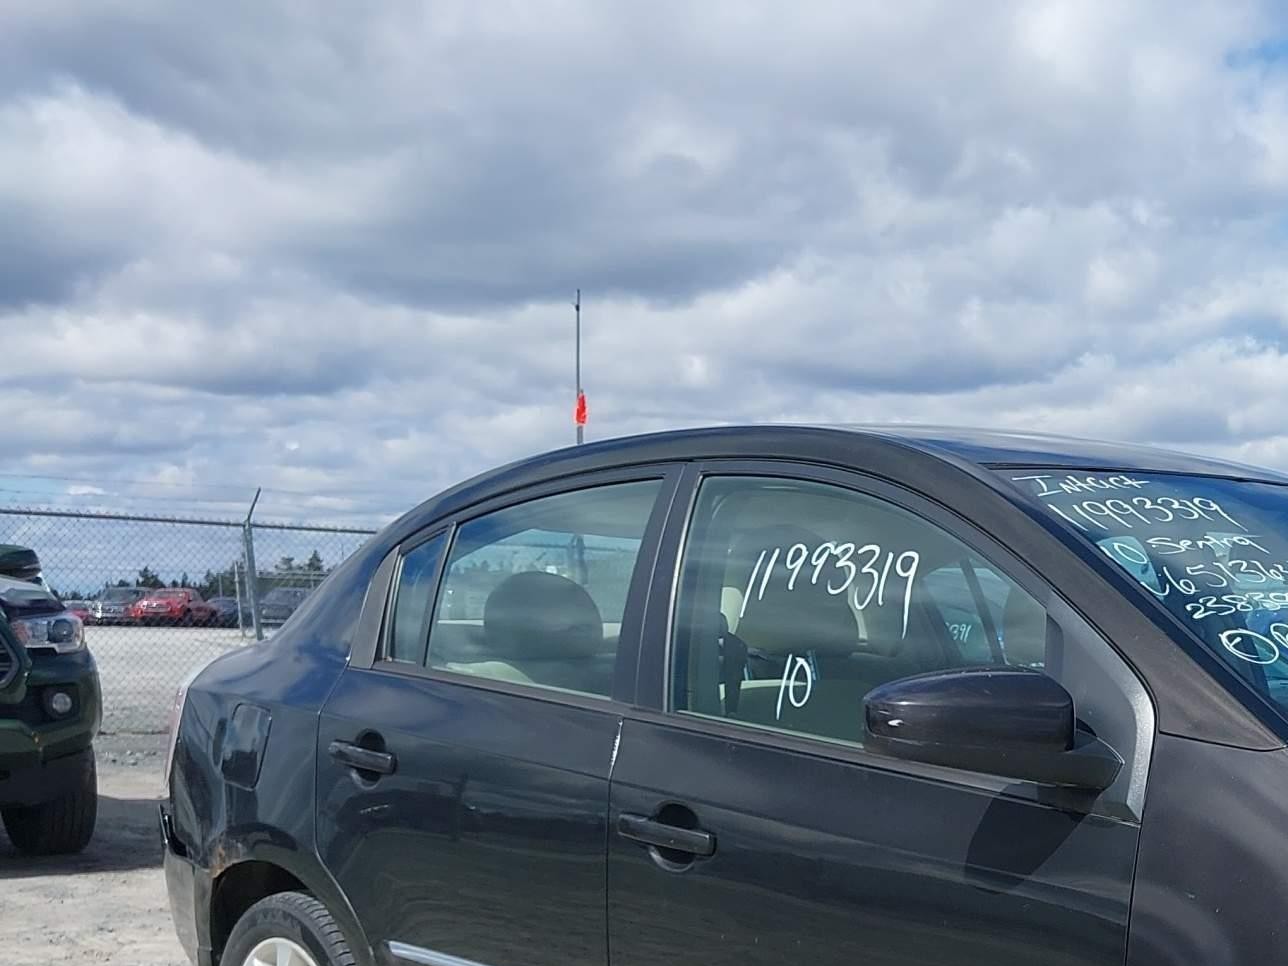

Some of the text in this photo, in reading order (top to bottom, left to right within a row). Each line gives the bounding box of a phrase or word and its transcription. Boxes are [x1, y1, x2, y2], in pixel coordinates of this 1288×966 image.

[1047, 496, 1249, 533] 11993319
[740, 543, 920, 641] 11993319
[776, 653, 812, 721] 10
